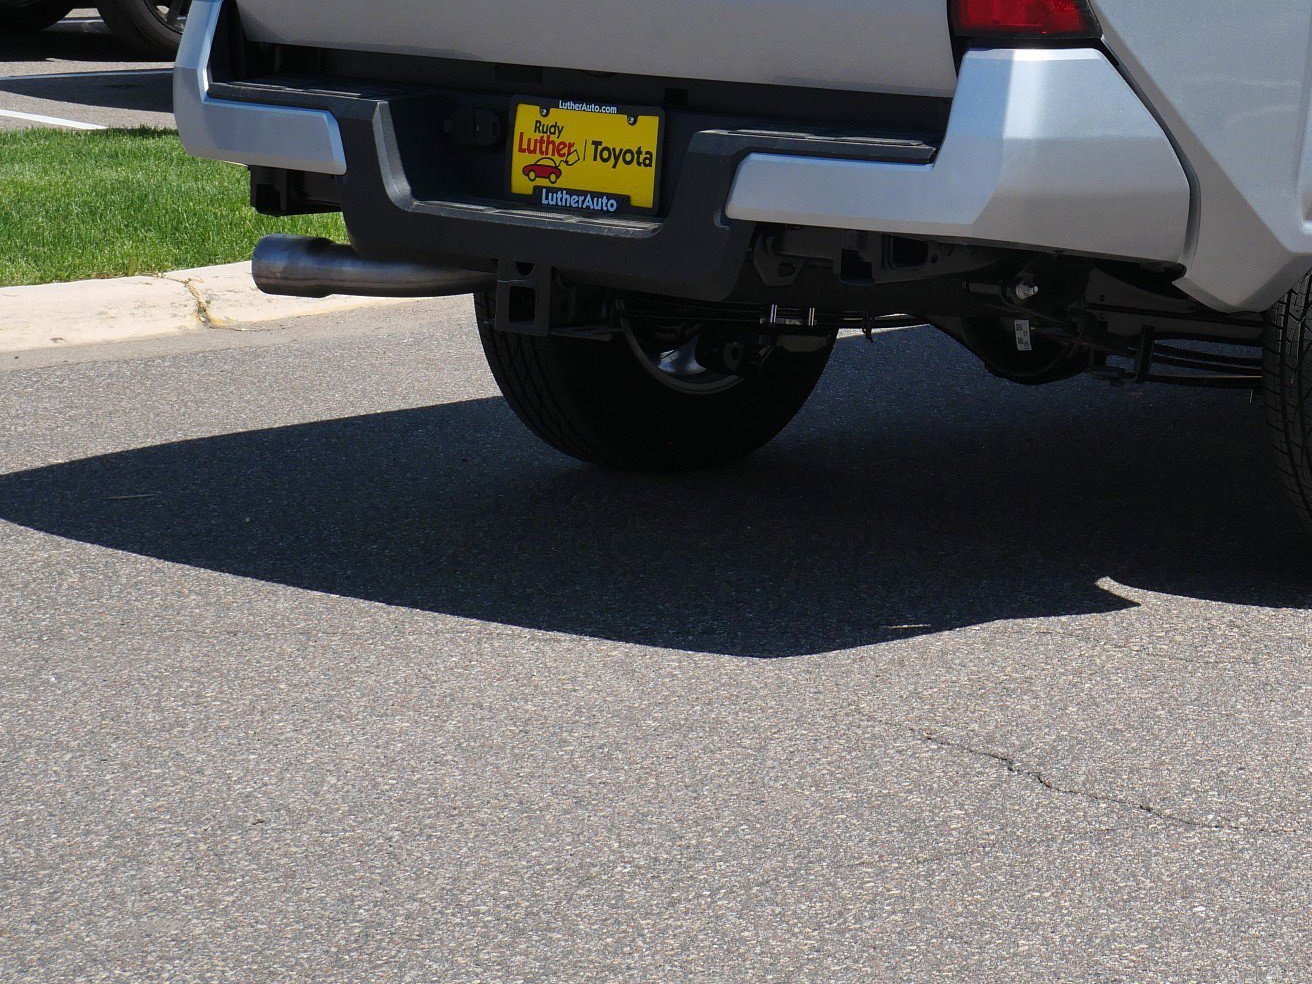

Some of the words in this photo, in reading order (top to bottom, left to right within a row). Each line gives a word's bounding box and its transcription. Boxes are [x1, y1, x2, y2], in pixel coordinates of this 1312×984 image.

[559, 100, 617, 115] LutherAuto.com
[534, 120, 564, 138] Rudy
[518, 132, 575, 158] Luther
[591, 140, 653, 169] Toyota
[542, 188, 617, 212] LutherAuto
